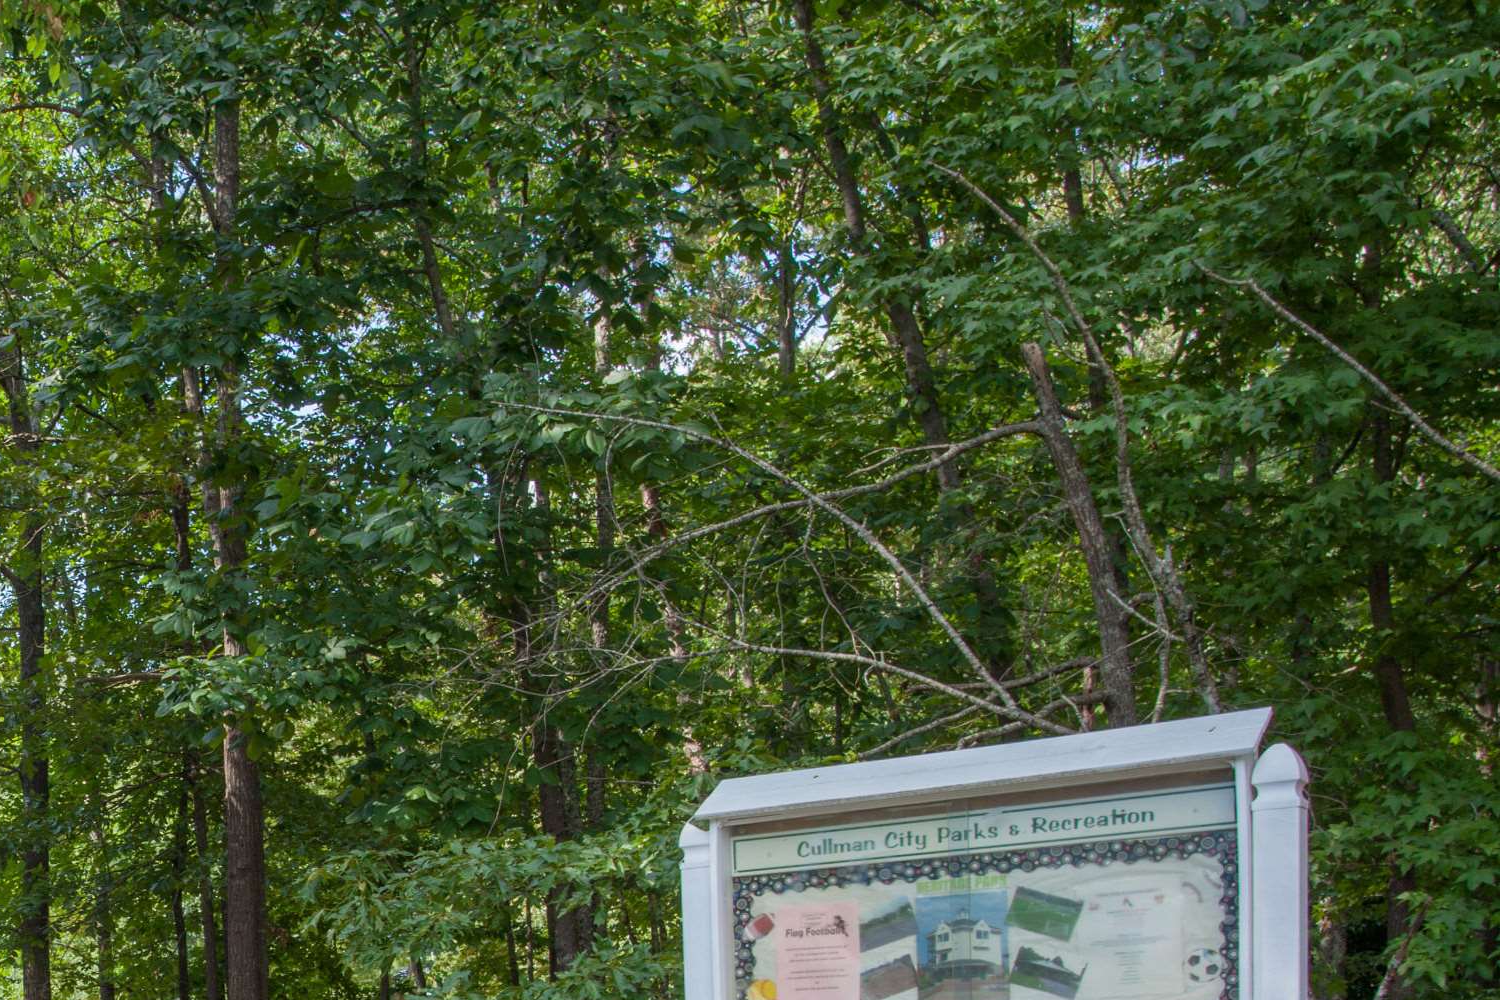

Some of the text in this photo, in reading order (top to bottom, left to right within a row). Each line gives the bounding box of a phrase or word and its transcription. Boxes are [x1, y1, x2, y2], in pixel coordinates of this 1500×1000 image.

[797, 808, 1155, 858] Cullman City Parks & Recreation
[785, 928, 804, 938] Flag
